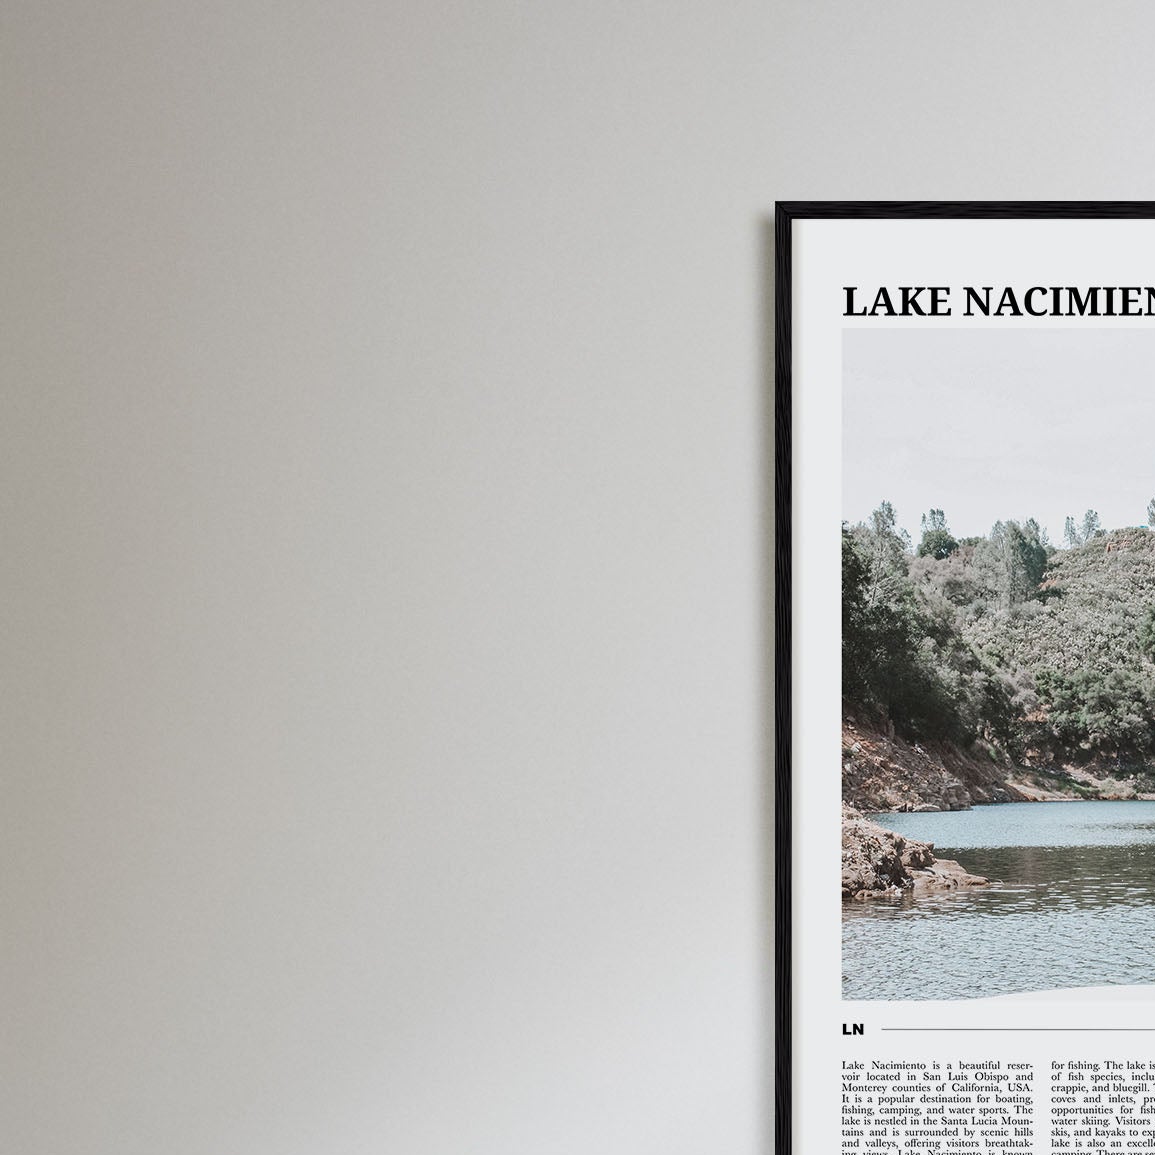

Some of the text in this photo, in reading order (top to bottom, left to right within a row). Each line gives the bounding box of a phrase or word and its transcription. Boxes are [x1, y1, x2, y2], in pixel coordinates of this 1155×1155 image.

[842, 287, 951, 316] LAKE
[842, 1023, 865, 1035] LN
[842, 1061, 865, 1070] Lake
[872, 1061, 926, 1070] Nacimiento
[933, 1061, 940, 1070] is
[959, 1061, 1000, 1070] beautiful
[841, 1072, 1033, 1083] voir located in San Luis Obispo and
[1051, 1072, 1062, 1081] of
[1068, 1072, 1084, 1081] fish
[1090, 1072, 1125, 1083] species,
[842, 1083, 1033, 1094] Monterey counties of California, USA.
[842, 1094, 849, 1103] It
[855, 1094, 862, 1103] is
[878, 1094, 915, 1105] popular
[920, 1094, 971, 1103] destination
[977, 1094, 990, 1103] for
[995, 1094, 1033, 1105] boating,
[1083, 1094, 1101, 1103] and
[1109, 1094, 1136, 1104] inlets,
[1051, 1105, 1114, 1117] opportunities
[1120, 1105, 1134, 1114] for
[1051, 1117, 1078, 1125] water
[1081, 1116, 1110, 1128] skiing.
[1116, 1116, 1151, 1125] Visitors
[842, 1128, 1034, 1139] tains and is surrounded by scenic hills
[841, 1139, 1033, 1150] and valleys, offering visitors breathtak-
[1051, 1139, 1070, 1148] lake
[1075, 1139, 1083, 1148] is
[1087, 1139, 1106, 1148] also
